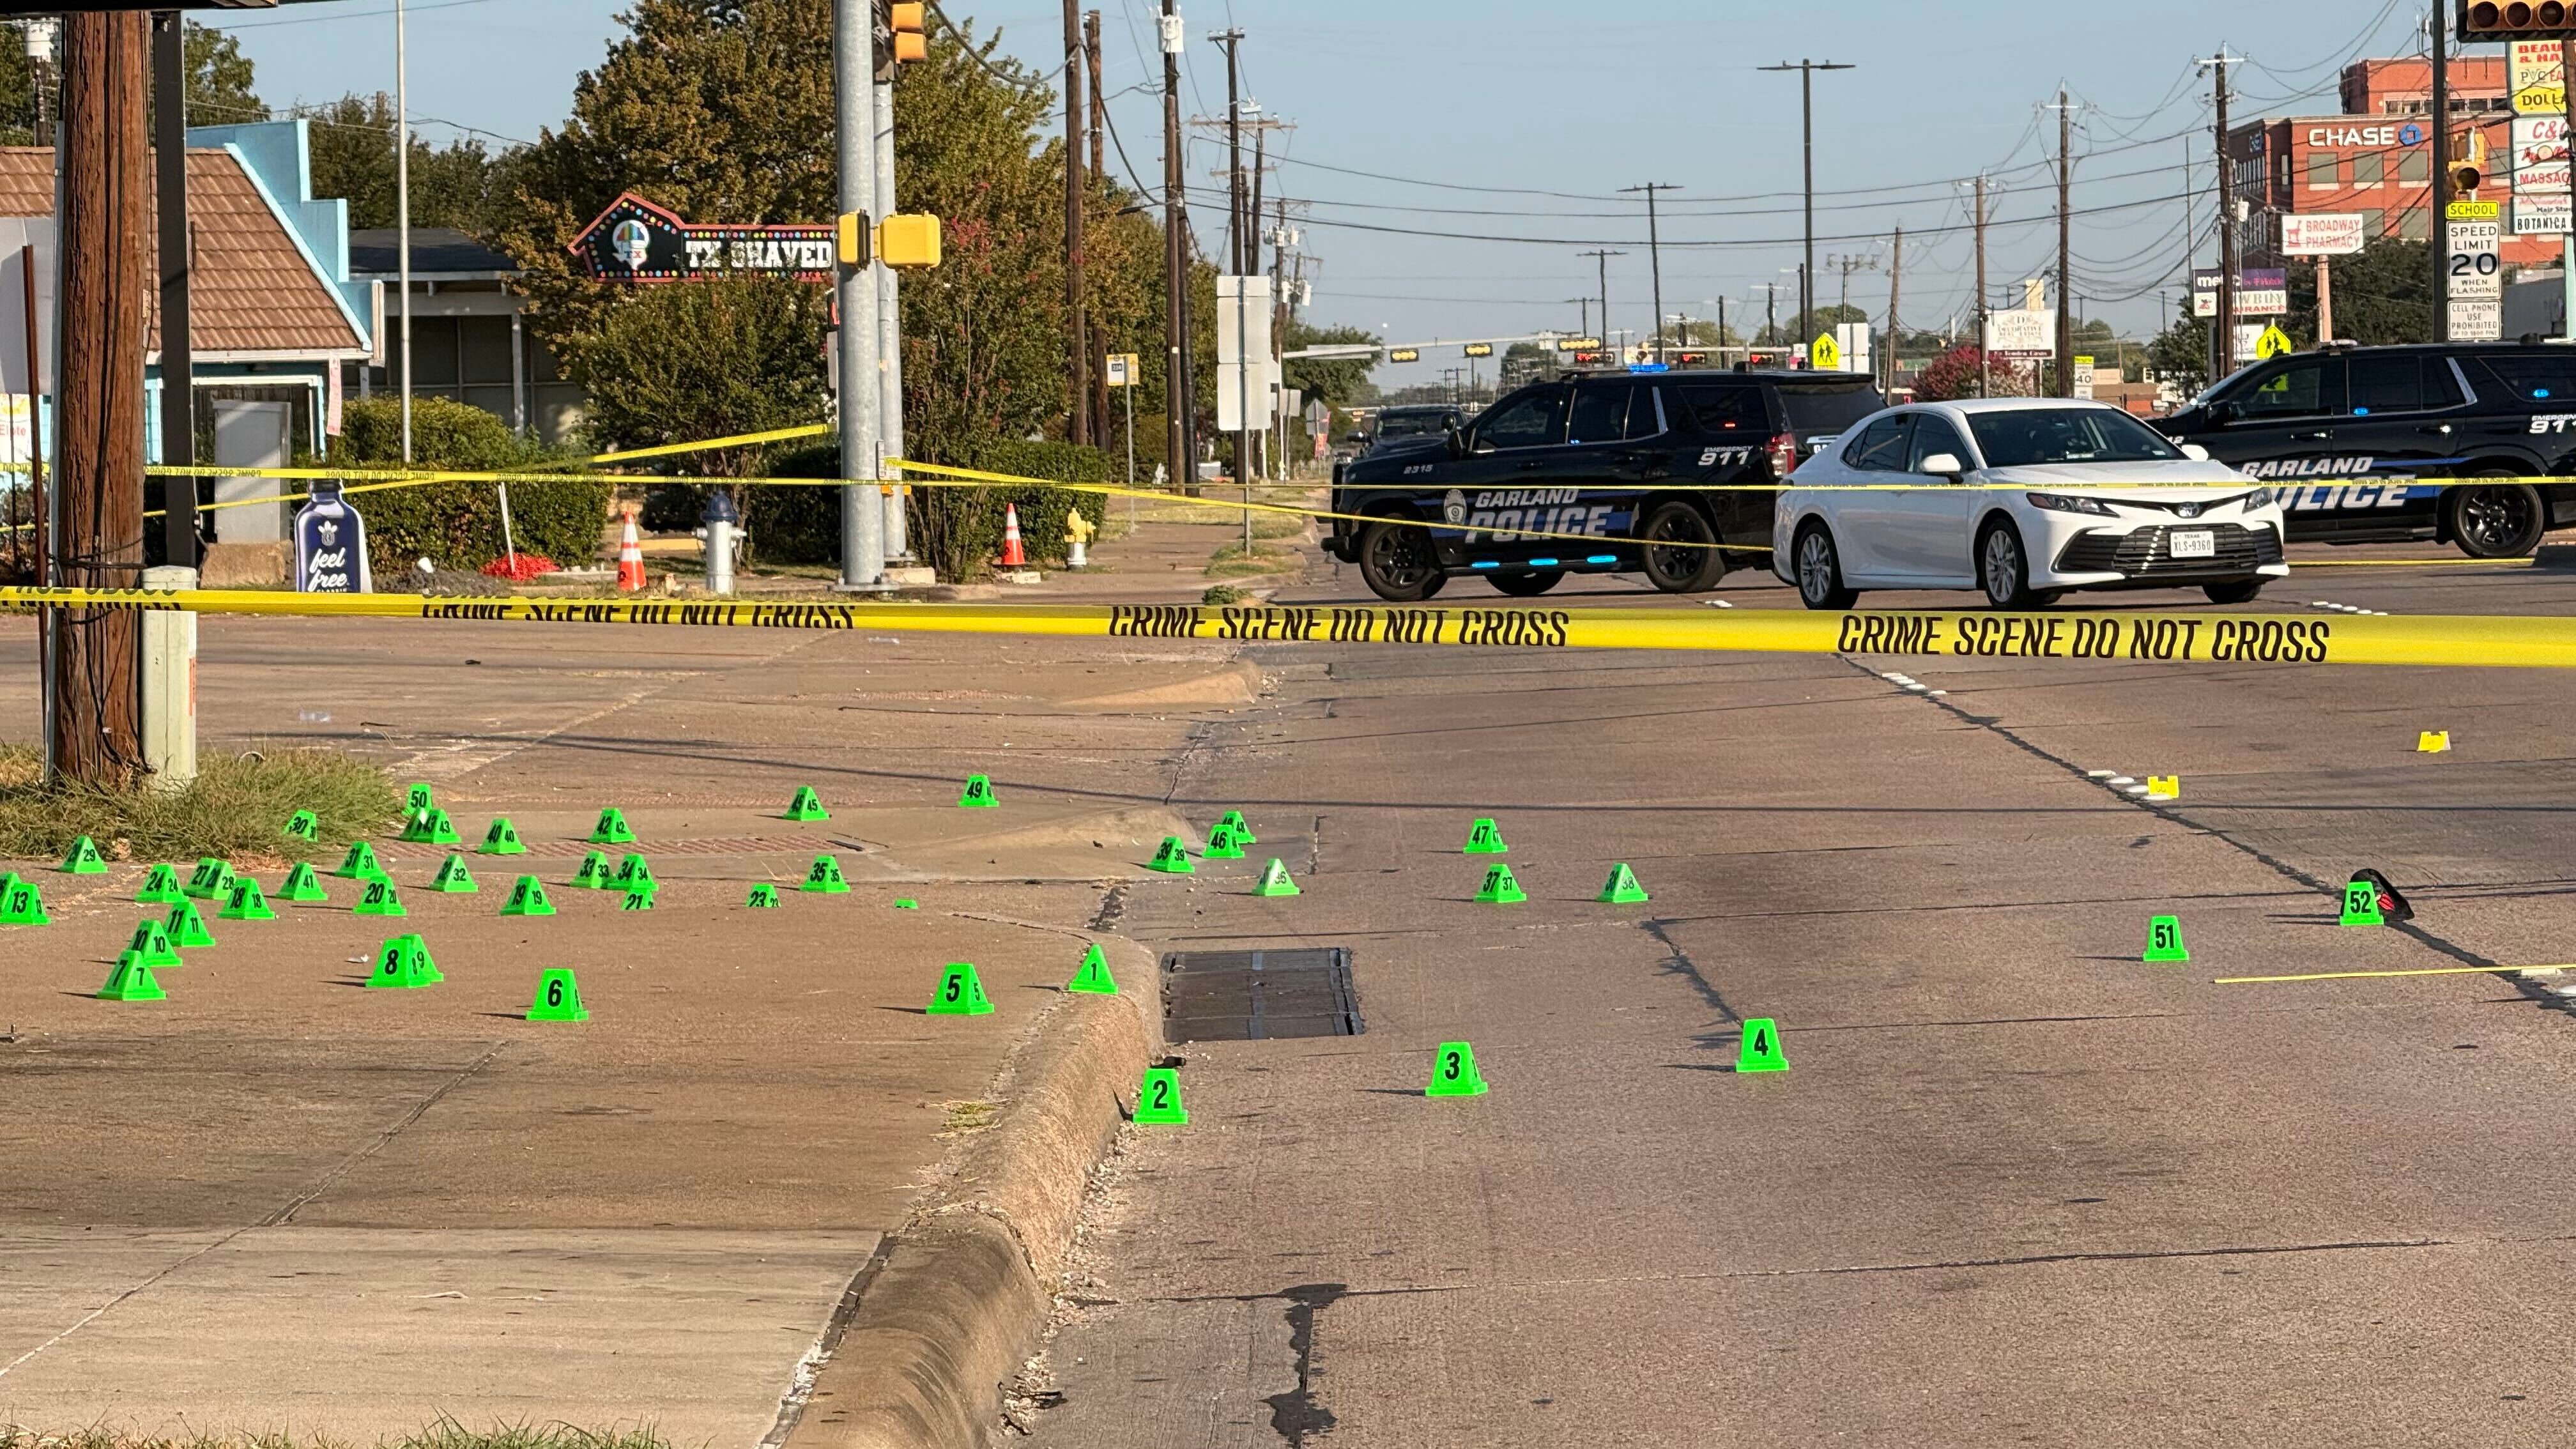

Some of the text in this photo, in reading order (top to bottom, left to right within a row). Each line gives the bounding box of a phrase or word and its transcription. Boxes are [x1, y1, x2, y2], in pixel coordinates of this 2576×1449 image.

[2308, 127, 2395, 146] CHASE
[2451, 205, 2496, 215] SCHOOL
[2306, 220, 2360, 233] BROADWAY
[2451, 227, 2497, 236] SPEED
[2518, 217, 2566, 230] BOTANICA
[2306, 236, 2359, 249] PHARMACY
[2455, 240, 2492, 250] LIMIT
[686, 241, 832, 268] TX SHAVED
[2451, 253, 2497, 276] 20
[2467, 312, 2482, 321] USE
[2076, 375, 2092, 383] 40
[0, 424, 26, 436] Elte
[1698, 451, 1749, 466] 911
[2241, 456, 2373, 477] GARLAND
[1475, 487, 1579, 509] GARLAND
[2272, 475, 2416, 510] OLICE
[1464, 507, 1613, 544] POLICE
[309, 547, 346, 573] feel
[307, 569, 348, 592] free
[1108, 606, 1570, 647] CRIME SCENE DO NOT CROSS
[1837, 615, 2331, 664] CRIME SCENE DO NOT CROSS
[410, 790, 427, 808] 50
[967, 781, 983, 799] 49
[807, 799, 818, 812] 45
[291, 816, 308, 834] 30
[440, 820, 450, 834] 43
[615, 821, 626, 835] 42
[504, 829, 515, 843] 40
[1211, 831, 1227, 849] 46
[1472, 826, 1489, 844] 47
[83, 848, 96, 862] 29
[1156, 842, 1173, 861] 39
[1174, 848, 1185, 862] 39
[364, 854, 374, 870] 31
[598, 864, 610, 878] 33
[618, 861, 634, 881] 34
[192, 865, 210, 885] 27
[303, 873, 314, 889] 41
[453, 867, 467, 882] 32
[638, 867, 648, 881] 34
[809, 862, 829, 882] 35
[830, 868, 840, 883] 35
[146, 871, 166, 893] 24
[168, 878, 179, 893] 24
[222, 876, 234, 891] 28
[1483, 871, 1500, 892] 37
[1503, 877, 1513, 891] 37
[12, 891, 29, 914] 13
[230, 886, 247, 908] 18
[252, 893, 262, 908] 18
[364, 882, 385, 905] 20
[388, 889, 397, 905] 20
[512, 884, 526, 906] 19
[532, 889, 543, 906] 19
[2350, 890, 2372, 914] 52
[167, 910, 185, 934] 11
[190, 917, 199, 934] 11
[153, 935, 166, 953] 10
[2155, 924, 2175, 949] 51
[385, 949, 399, 975] 8
[417, 951, 425, 969] 9
[112, 960, 128, 986] 7
[136, 967, 145, 986] 7
[1090, 963, 1097, 981] 1
[547, 978, 563, 1008] 6
[946, 974, 962, 1002] 5
[973, 982, 981, 1002] 5
[1754, 1028, 1768, 1057] 4
[1445, 1051, 1460, 1080] 3
[1153, 1080, 1168, 1109] 2
